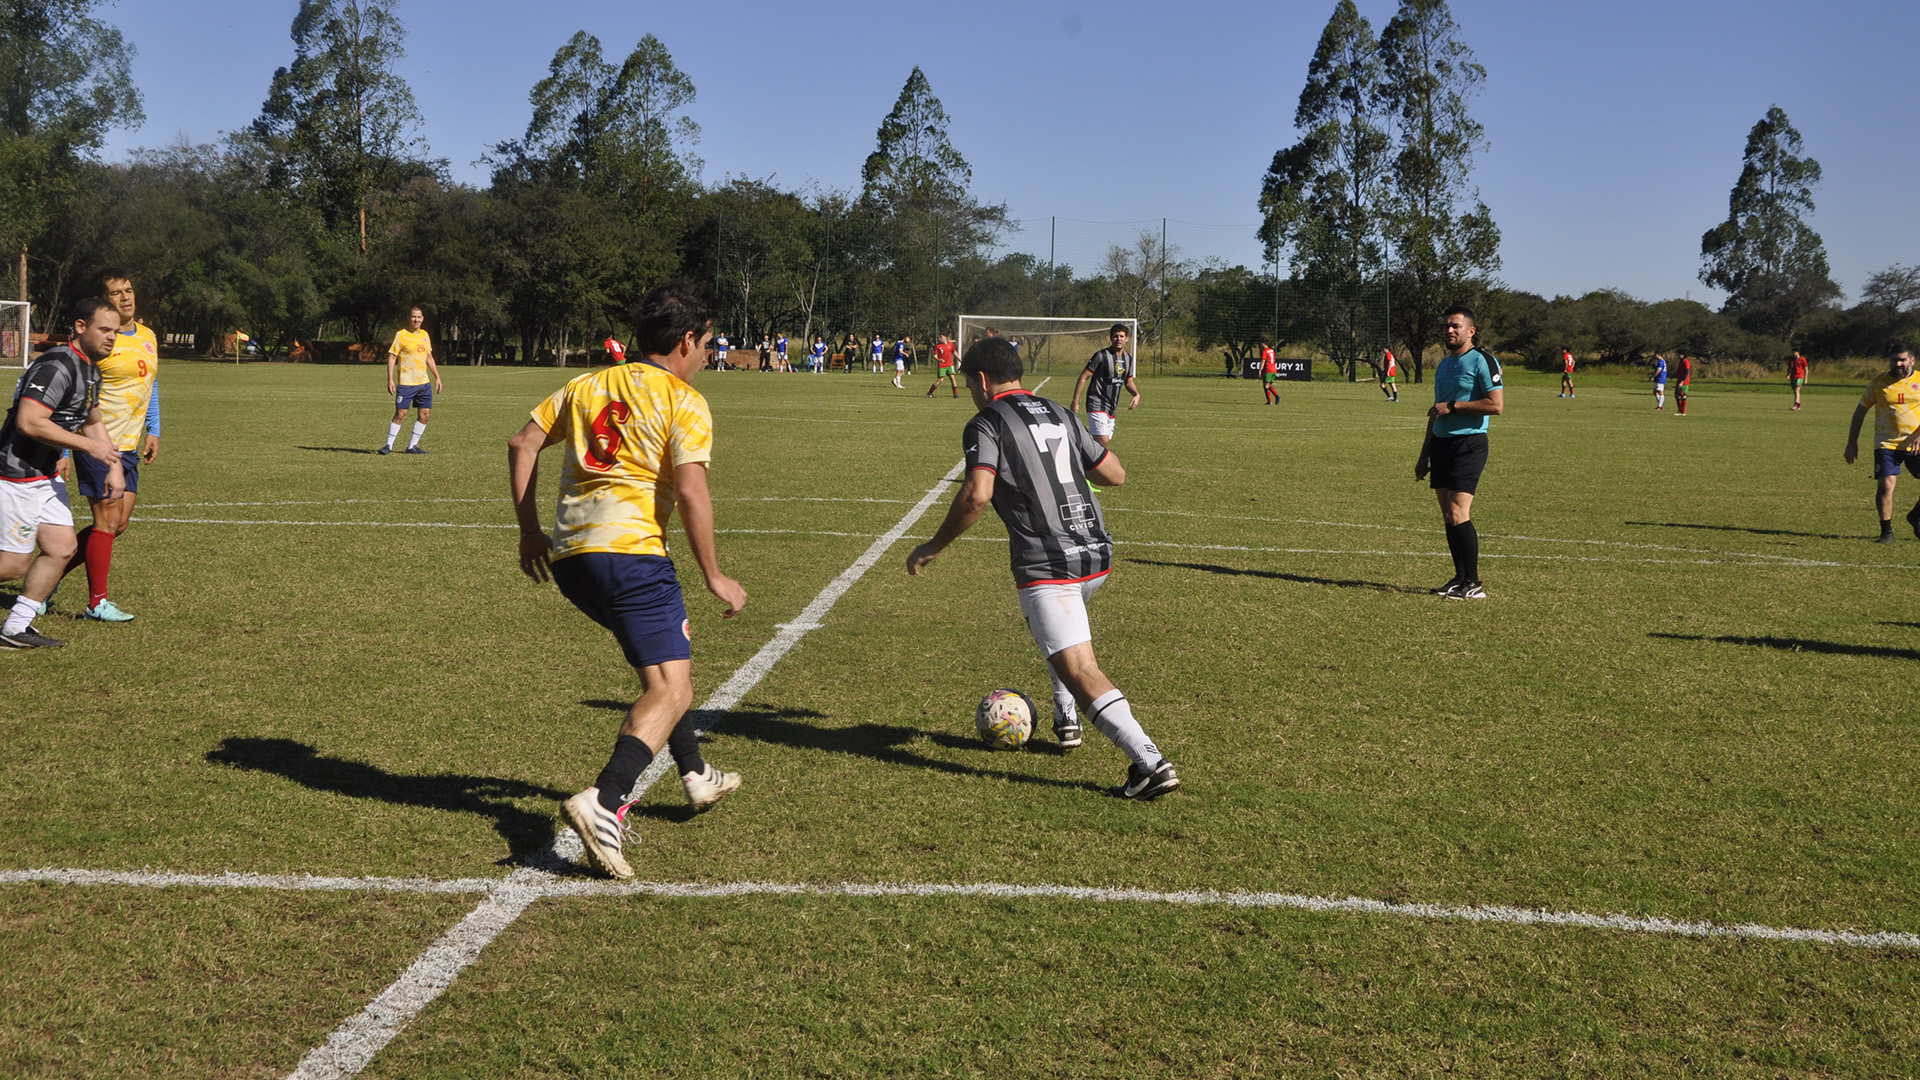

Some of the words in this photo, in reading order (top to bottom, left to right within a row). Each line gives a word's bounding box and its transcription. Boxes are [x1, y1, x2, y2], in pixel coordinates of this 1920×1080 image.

[136, 359, 148, 378] 9
[1250, 362, 1294, 370] CEURY
[1898, 393, 1905, 404] 11
[583, 400, 632, 472] 6
[1029, 423, 1074, 484] 7
[1069, 521, 1094, 531] CIVIS
